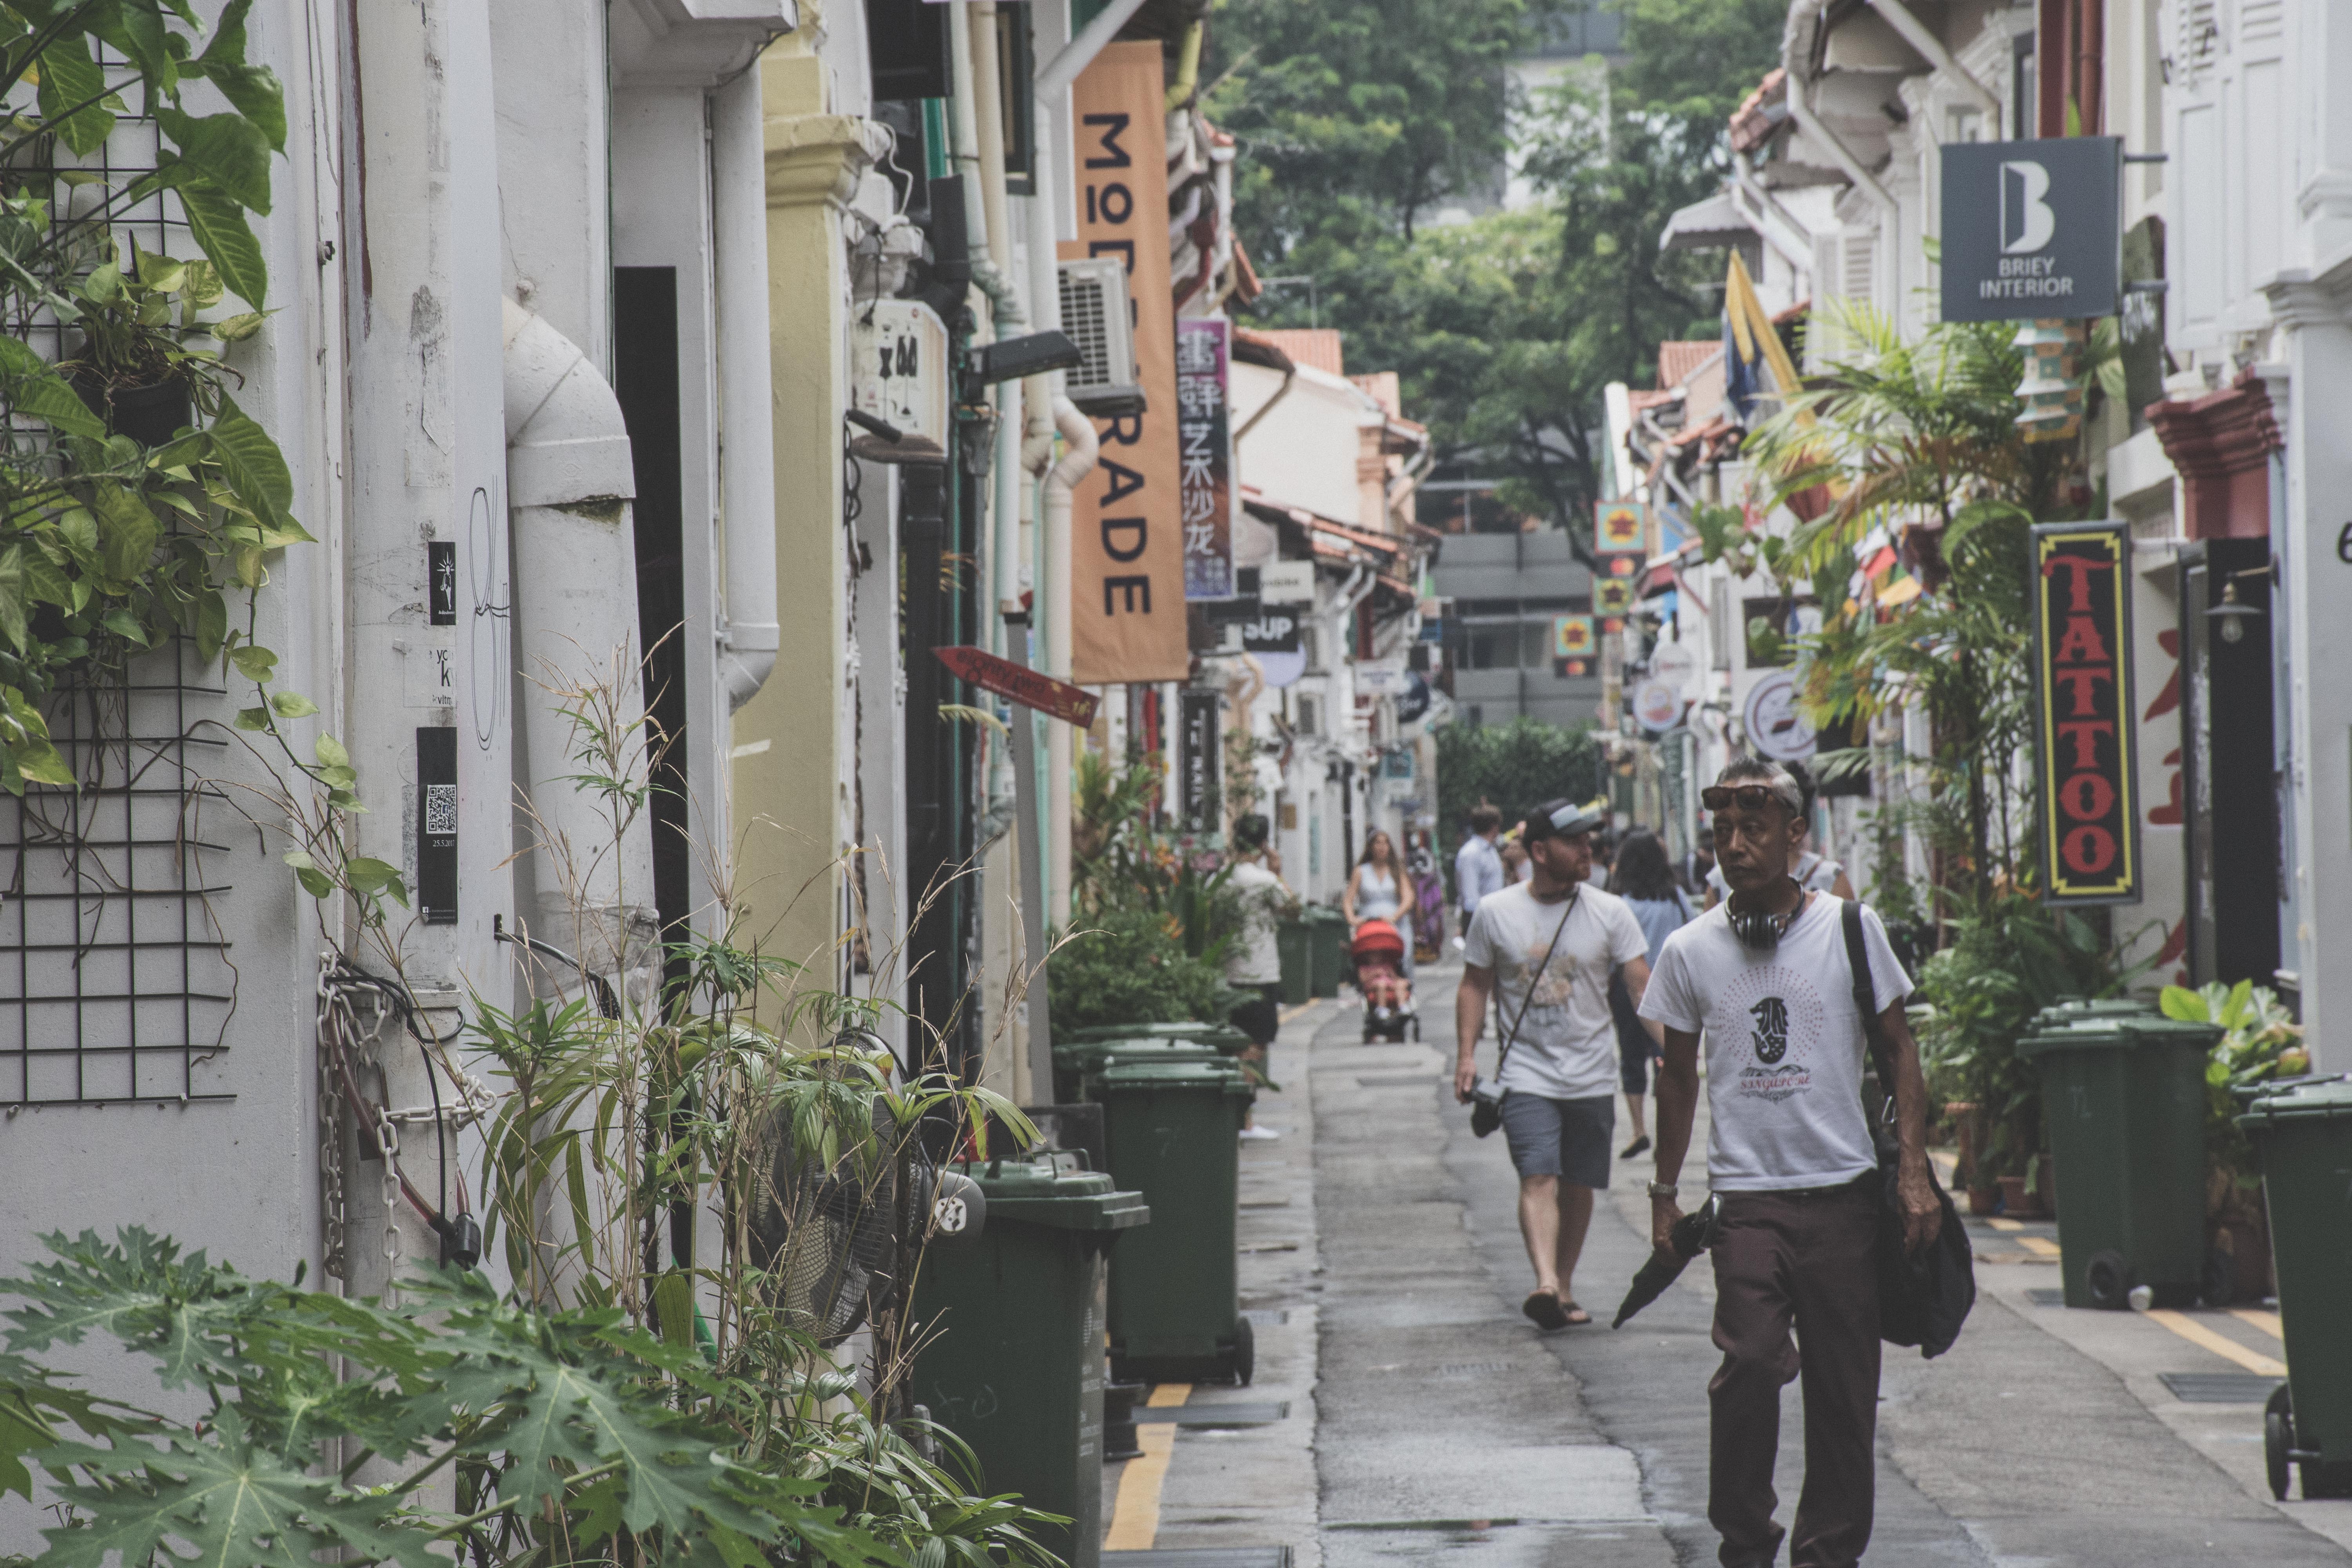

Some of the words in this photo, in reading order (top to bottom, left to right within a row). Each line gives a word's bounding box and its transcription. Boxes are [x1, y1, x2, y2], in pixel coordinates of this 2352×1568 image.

[1999, 256, 2056, 278] BRIEY
[1980, 277, 2074, 299] INTERIOR
[2042, 554, 2118, 874] TATTOO
[432, 839, 455, 848] 25.5.2017
